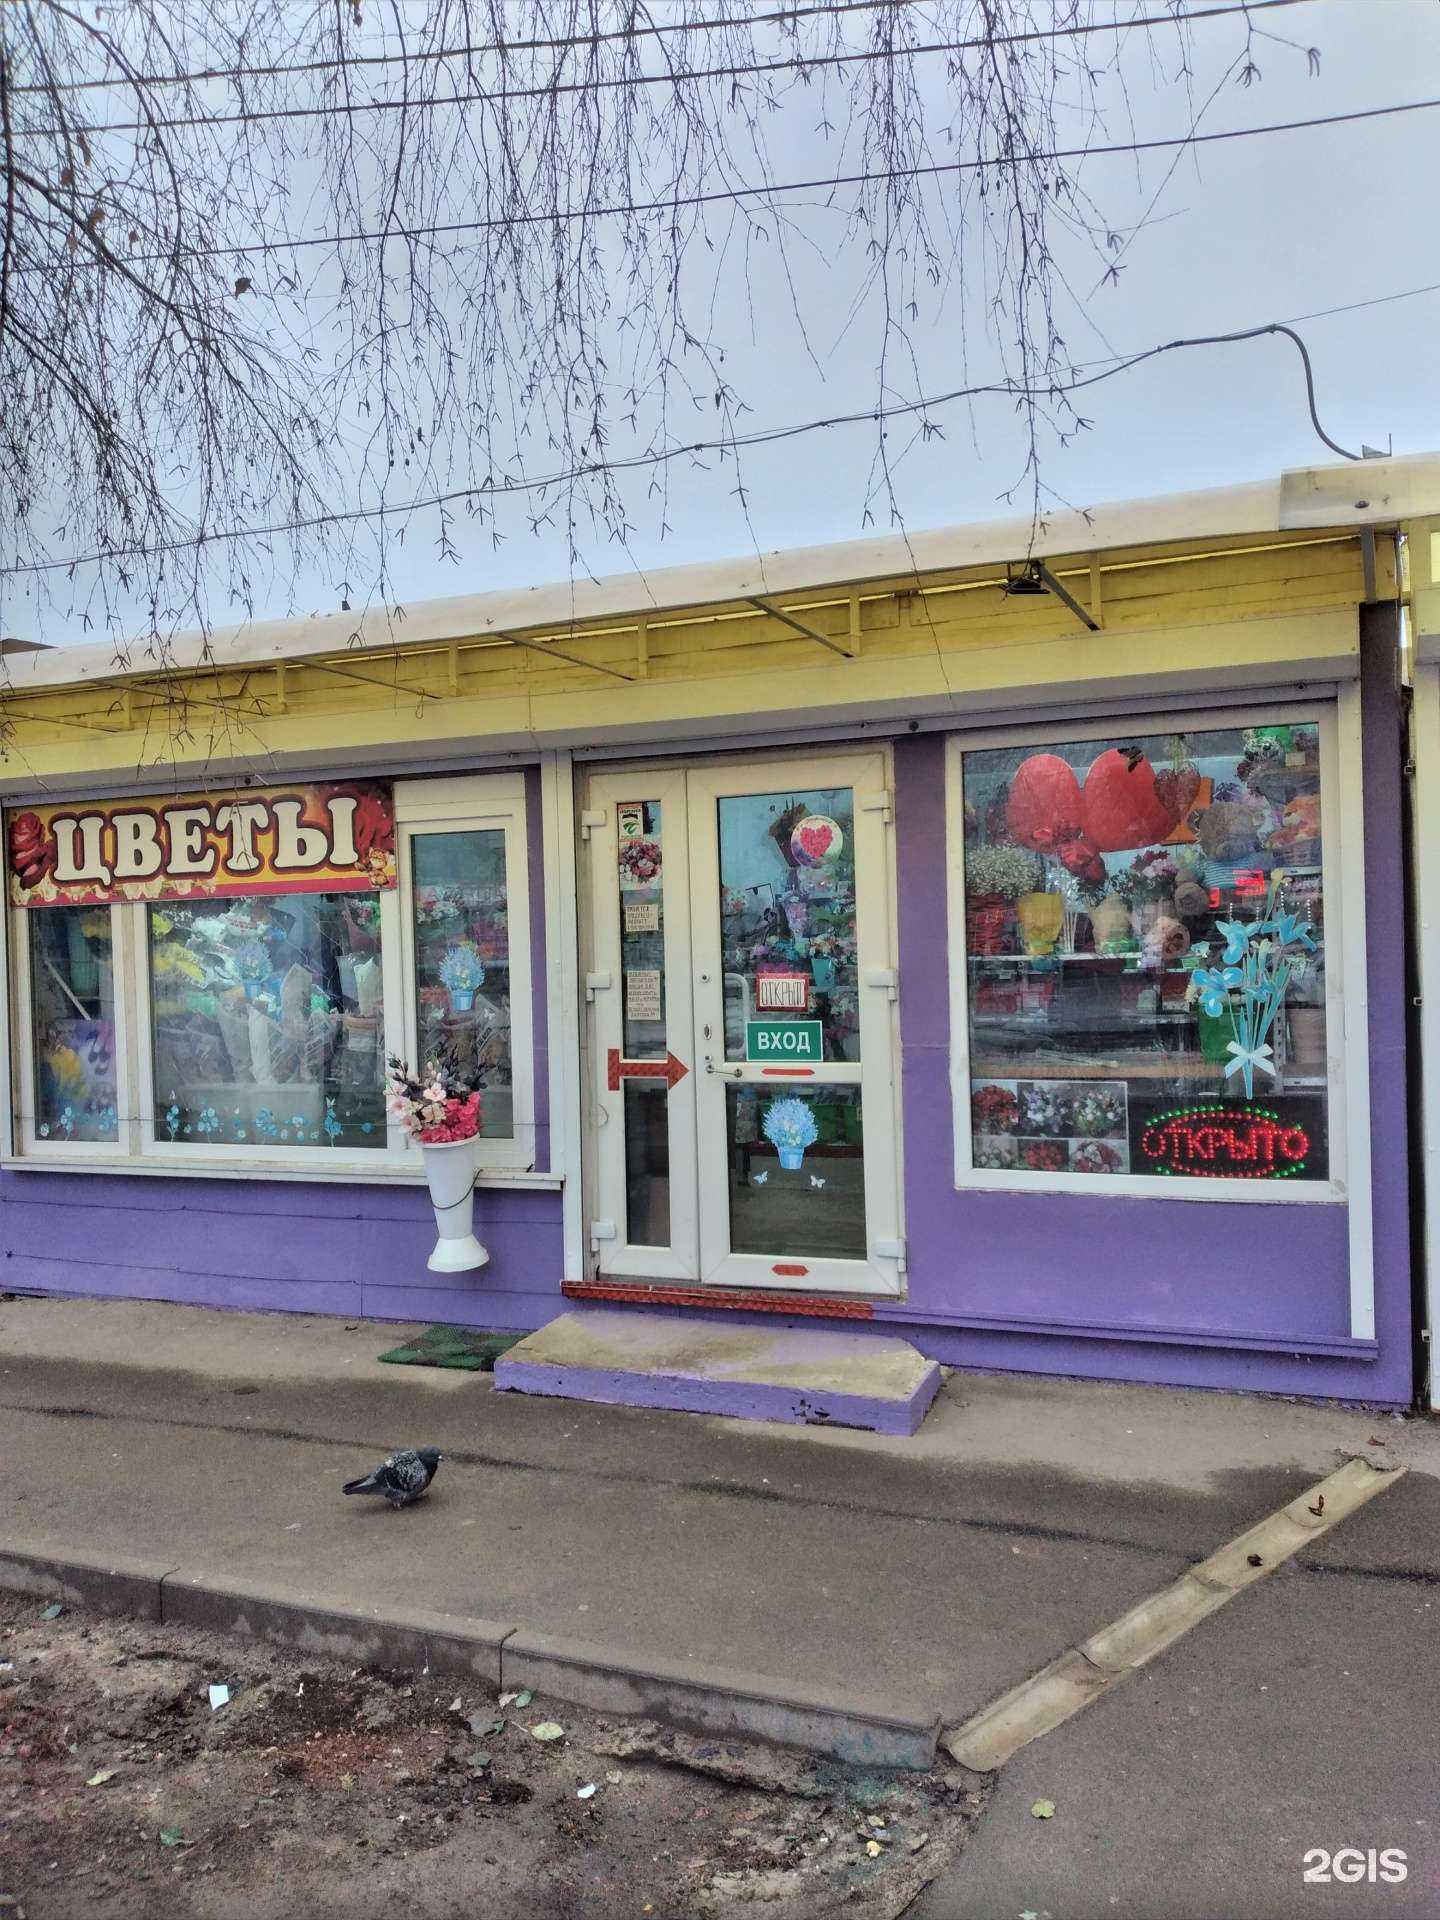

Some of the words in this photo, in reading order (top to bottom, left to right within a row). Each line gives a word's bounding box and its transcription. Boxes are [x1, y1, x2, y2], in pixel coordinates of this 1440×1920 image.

[52, 796, 359, 886] ЦВЕТЫ
[757, 1031, 811, 1053] ВХОД
[1141, 1125, 1310, 1161] ОТКРЫТО
